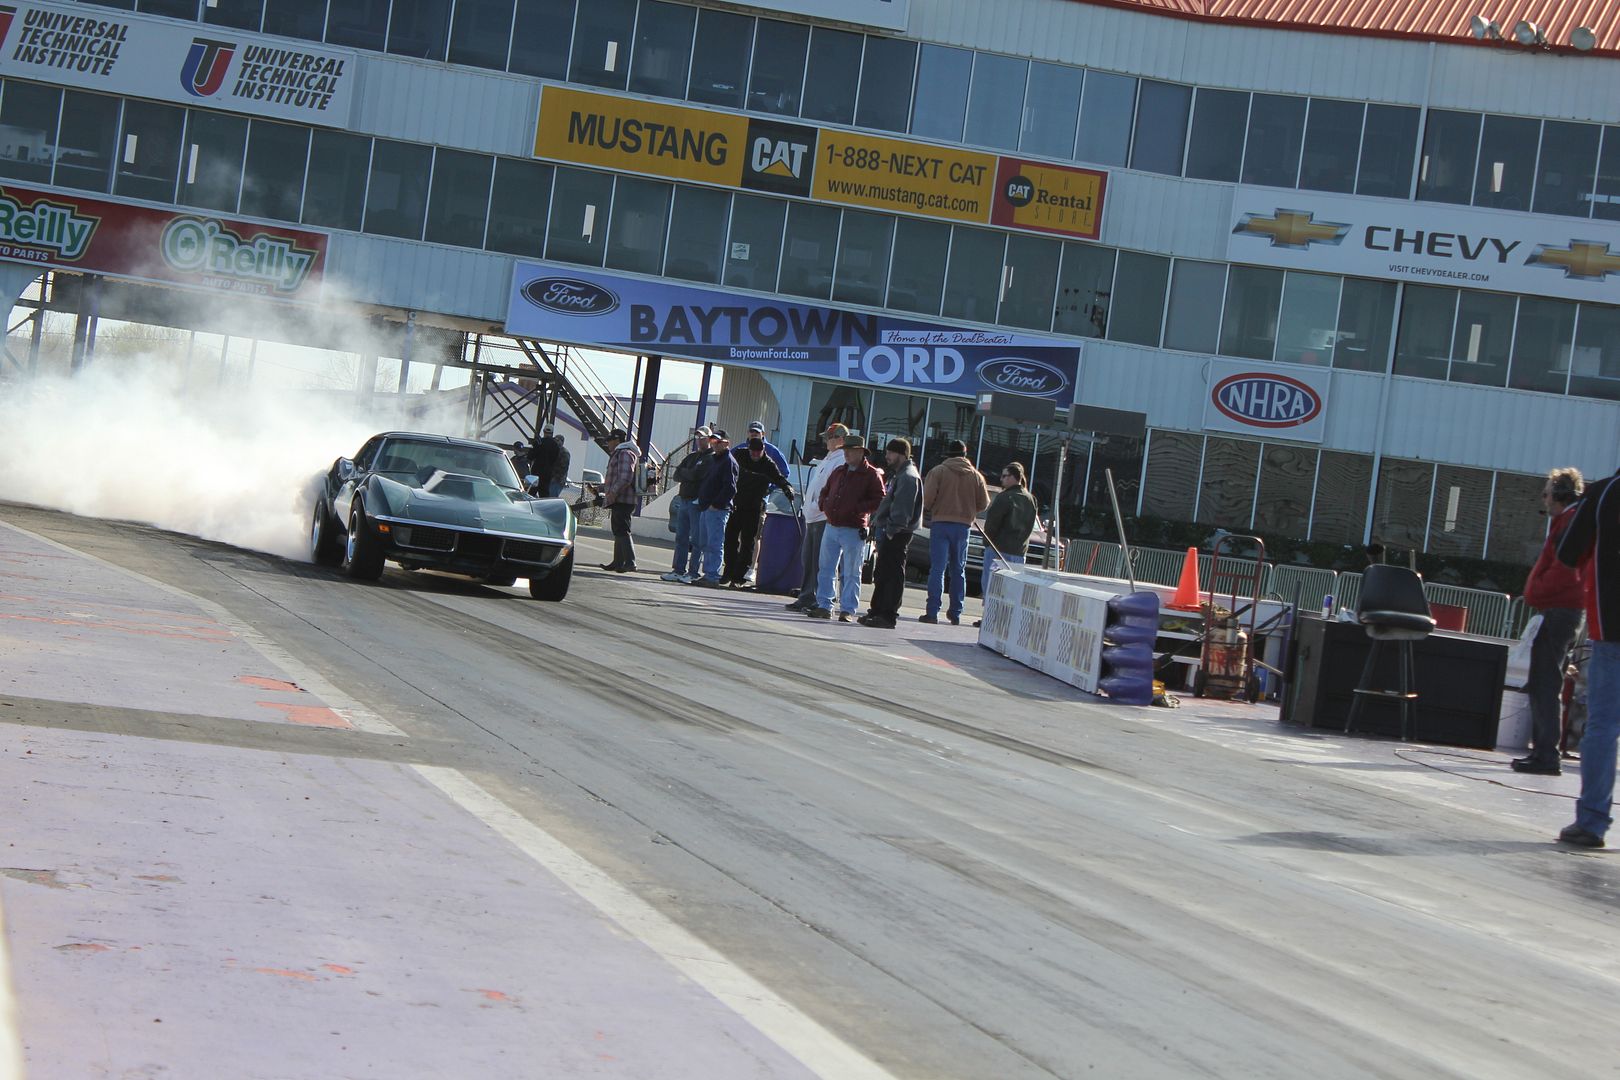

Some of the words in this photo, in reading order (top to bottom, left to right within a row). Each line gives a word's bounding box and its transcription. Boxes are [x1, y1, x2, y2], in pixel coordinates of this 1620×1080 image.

[24, 9, 128, 42] UNIVERSAL
[19, 26, 121, 59] TECHNICAL
[13, 44, 116, 76] INSTITUTE
[243, 45, 345, 76] UNIVERSAL
[239, 62, 338, 93] TECHNICAL
[232, 80, 332, 110] INSTITUTE
[568, 111, 728, 166] MUSTANG
[751, 137, 808, 179] CAT
[826, 143, 943, 179] 1-888-NEXT
[950, 162, 987, 186] CAT
[1008, 183, 1030, 199] CAT
[1036, 189, 1092, 210] Rental
[13, 248, 49, 261] PARTS
[169, 222, 306, 285] O'Reilly
[1364, 226, 1521, 263] CHEVY
[232, 280, 268, 295] PARTS
[1389, 264, 1409, 273] VISIT
[1411, 267, 1489, 281] CHEVYDEALER.COM
[543, 281, 597, 309] Ford
[630, 304, 878, 346] BAYTOWN
[887, 331, 916, 343] Home
[920, 332, 932, 346] of
[933, 332, 949, 343] the
[730, 347, 809, 360] BaytownFord.com
[839, 345, 965, 384] FORD
[996, 364, 1046, 391] Ford
[1228, 382, 1305, 418] NHRA
